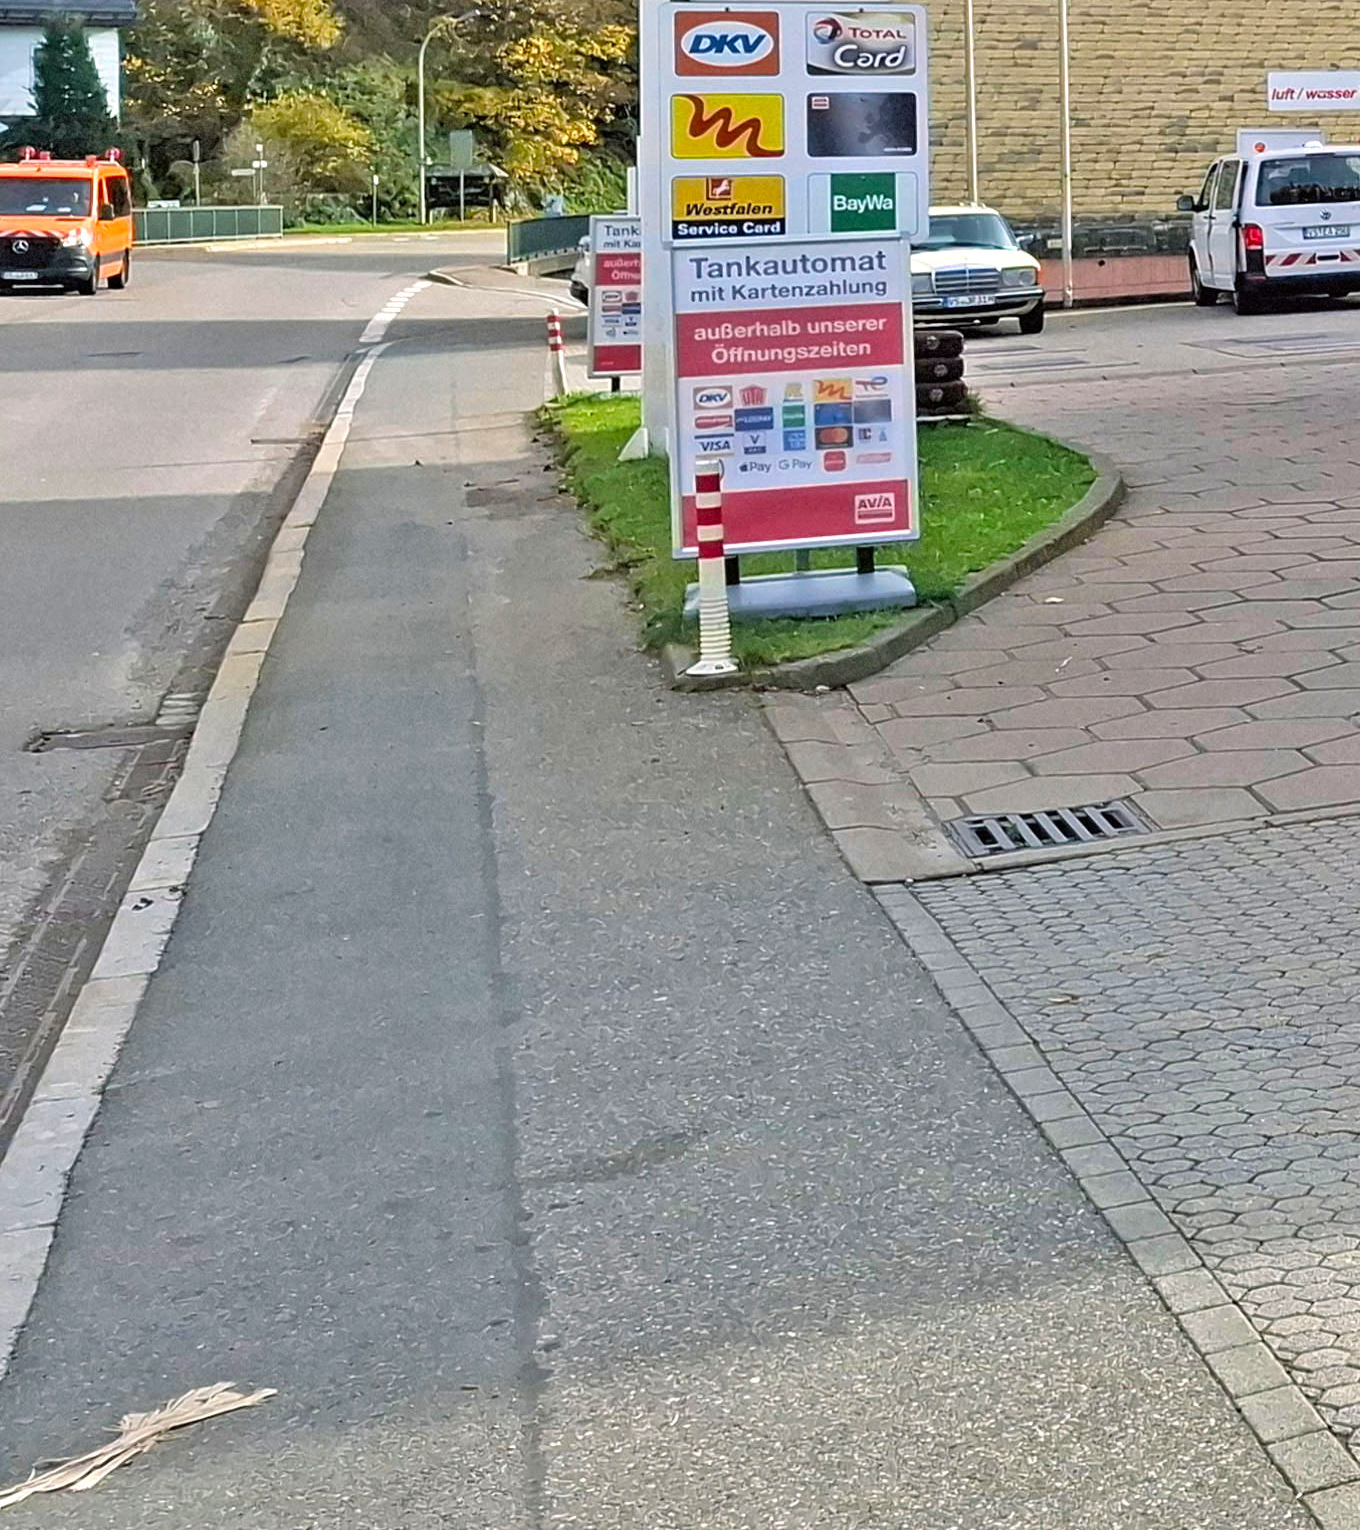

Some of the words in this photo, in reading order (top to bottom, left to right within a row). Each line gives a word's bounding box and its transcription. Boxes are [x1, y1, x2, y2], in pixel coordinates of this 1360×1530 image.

[848, 27, 907, 40] TOTAL
[689, 34, 767, 55] DKV
[834, 44, 906, 68] Card
[1271, 87, 1295, 101] luft
[1306, 88, 1357, 100] wasser
[685, 201, 773, 216] Westfalen
[832, 194, 894, 214] BayWa
[604, 225, 641, 237] Tank
[677, 222, 738, 236] Service
[742, 221, 781, 234] Card
[603, 240, 621, 248] mit
[689, 250, 887, 279] Tankautomat
[690, 285, 725, 303] mit
[732, 279, 888, 302] Kartenzahlung
[694, 319, 801, 342] außerhalb
[807, 317, 887, 334] unserer
[711, 341, 871, 364] Öffnungszeiten
[698, 392, 728, 404] DKV
[700, 440, 731, 452] VISA
[750, 461, 772, 474] Pay
[792, 459, 813, 471] Pay
[857, 494, 893, 510] AVIA
